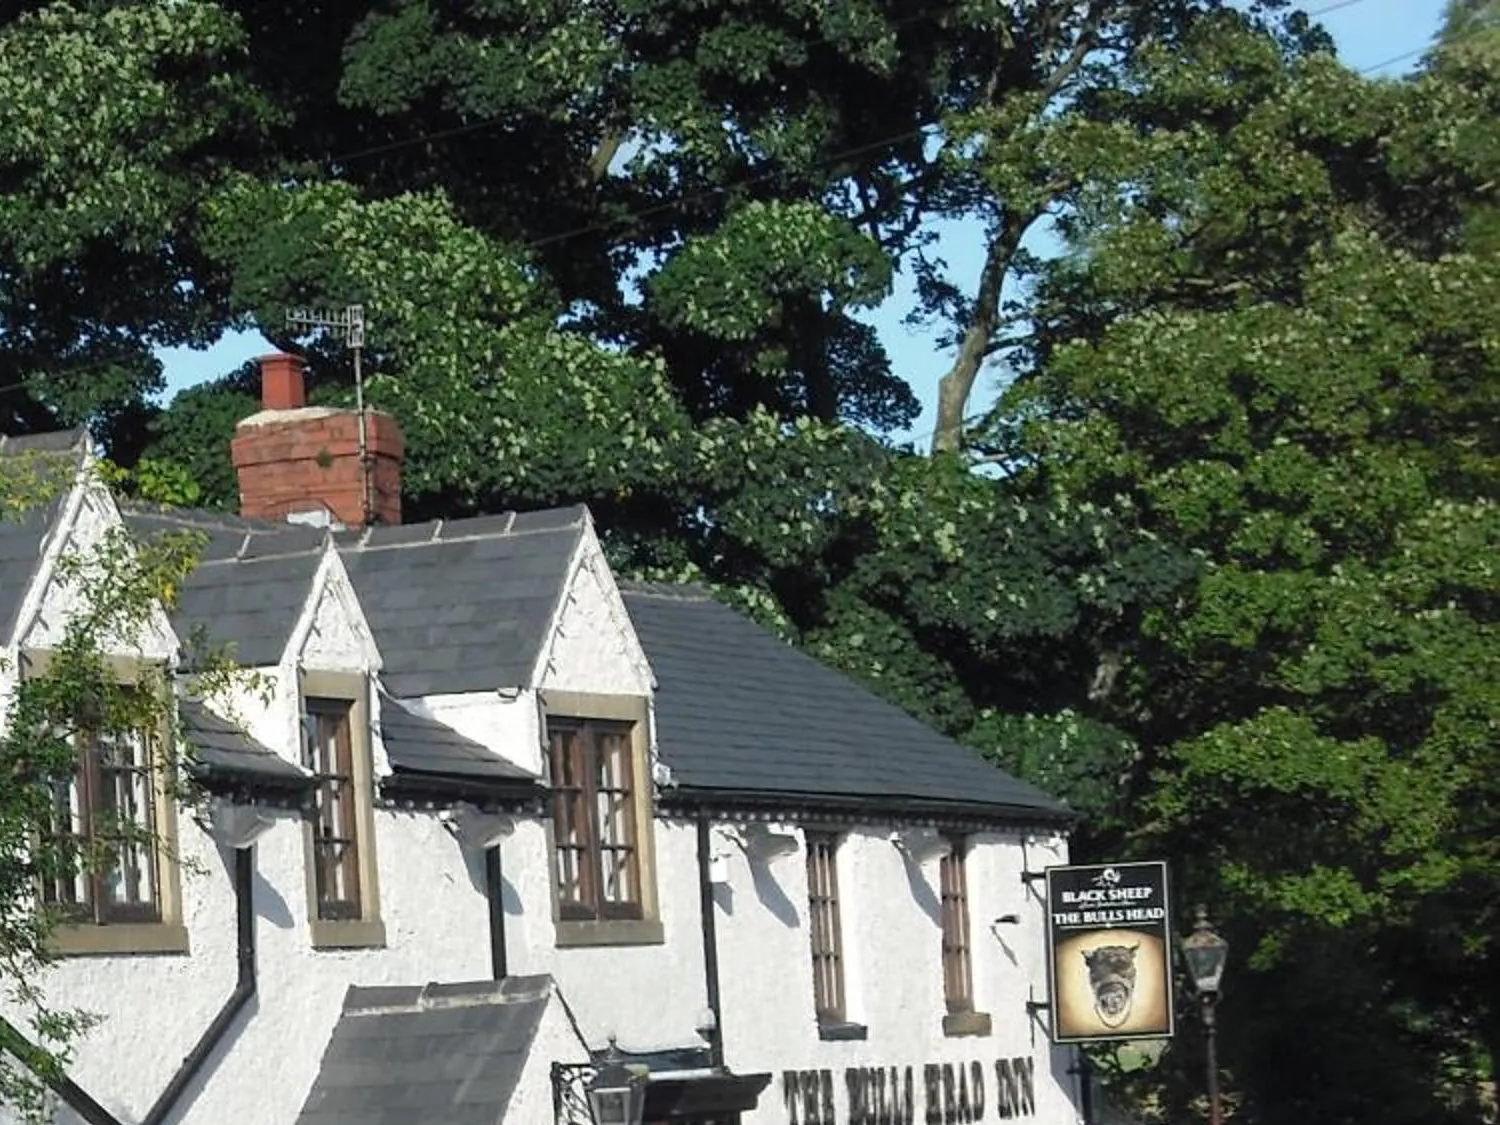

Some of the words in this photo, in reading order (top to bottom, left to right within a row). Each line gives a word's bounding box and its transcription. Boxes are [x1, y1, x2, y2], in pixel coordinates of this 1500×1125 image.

[1061, 889, 1106, 903] BLACK
[1107, 886, 1153, 901] SHEEP
[1052, 911, 1081, 925] THE
[1083, 909, 1124, 923] BULLS
[1126, 906, 1164, 921] HEAD
[995, 1055, 1035, 1120] INN
